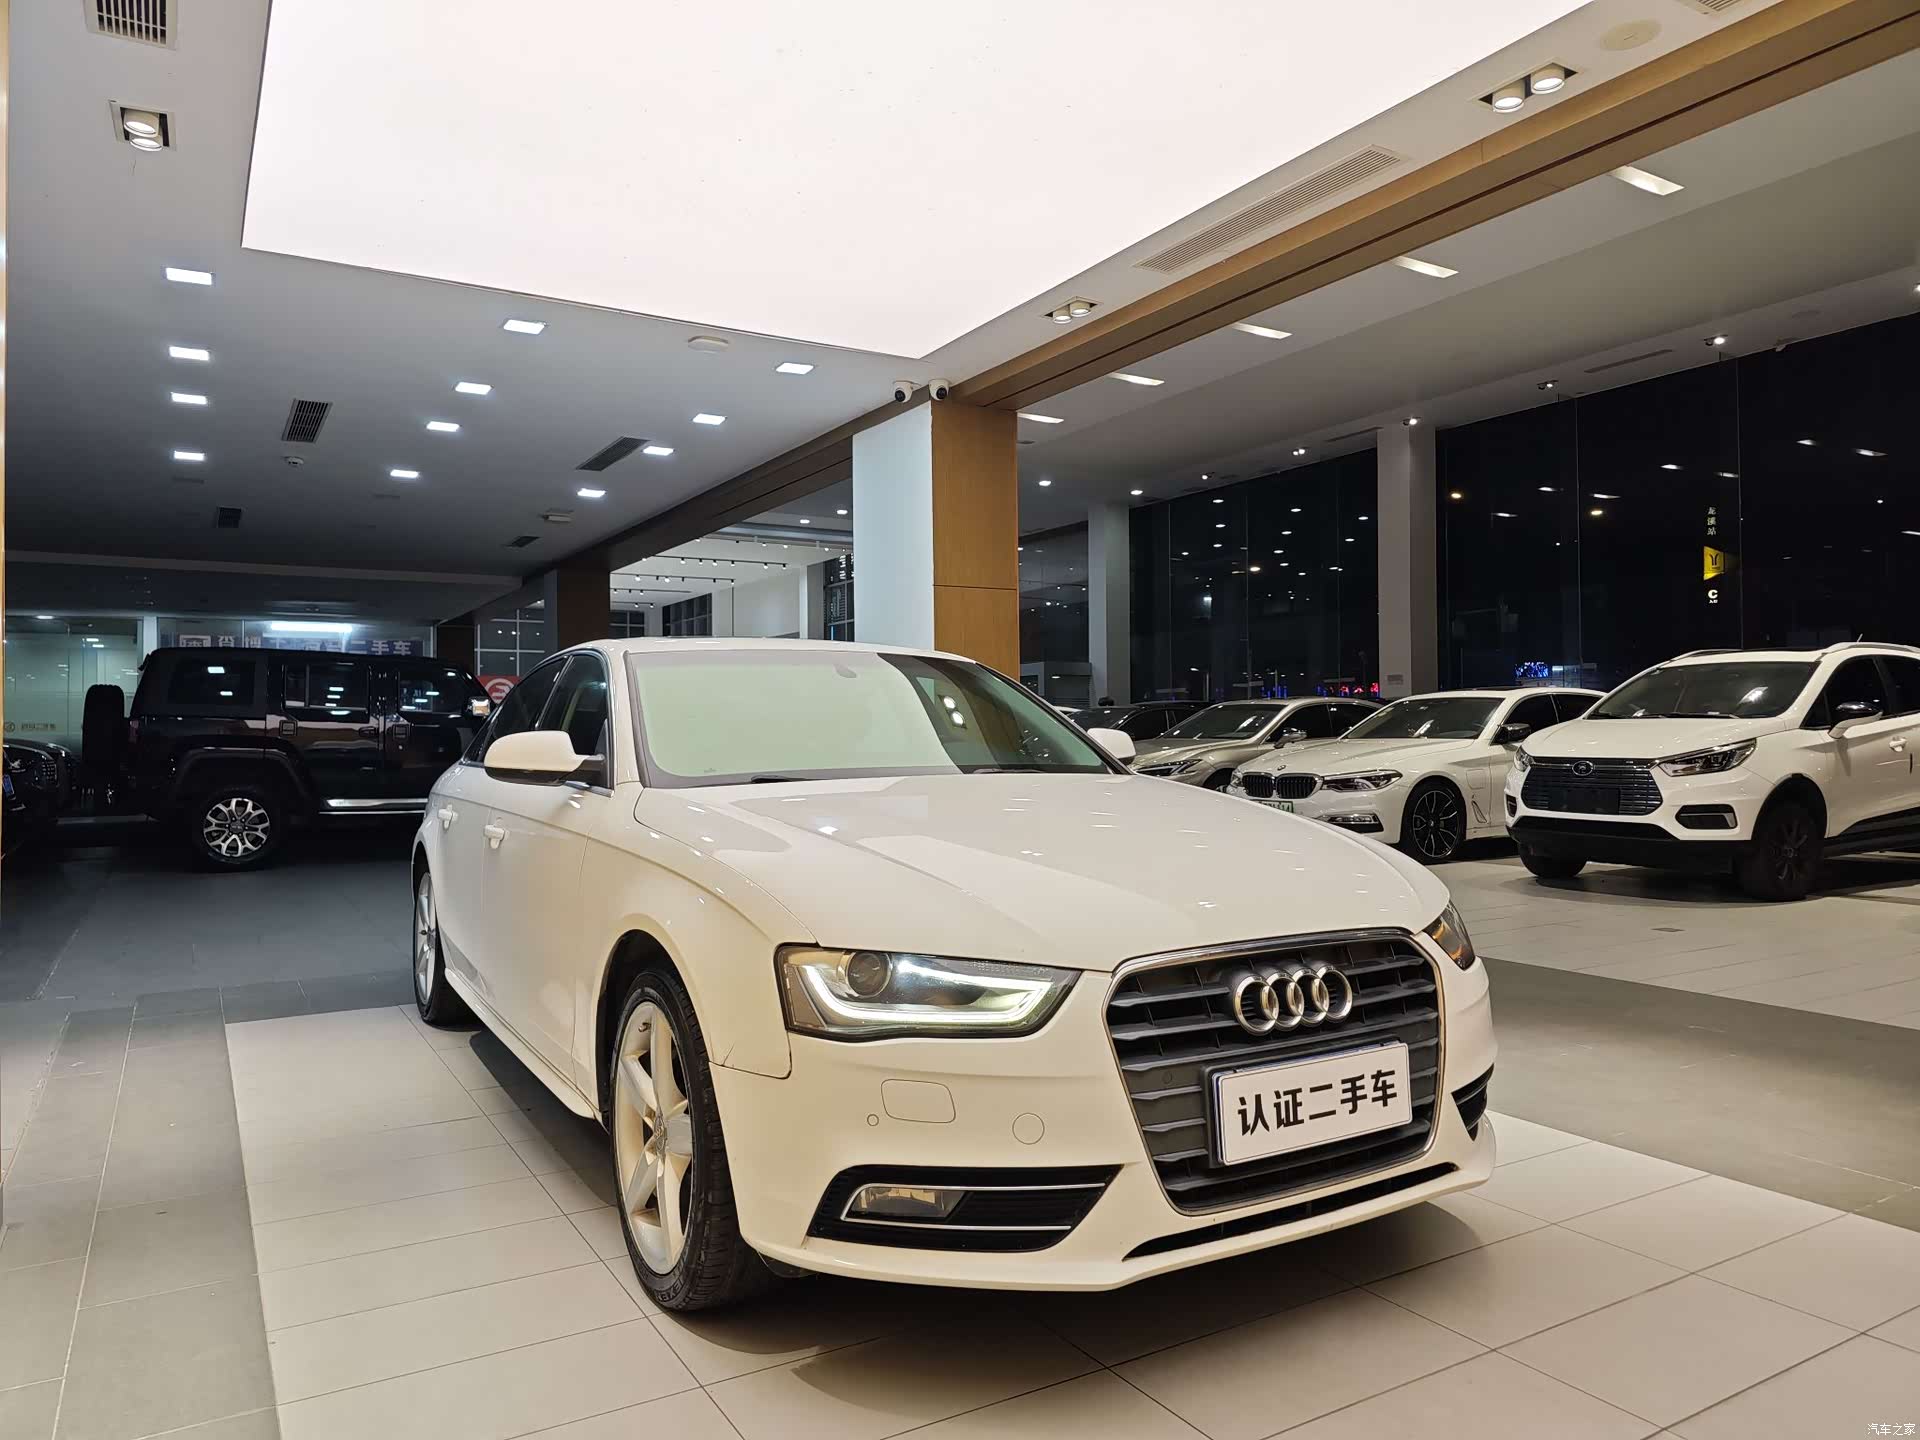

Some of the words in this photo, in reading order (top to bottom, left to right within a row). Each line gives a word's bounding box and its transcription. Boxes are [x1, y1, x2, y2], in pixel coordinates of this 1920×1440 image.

[1707, 589, 1719, 599] C
[1237, 1069, 1398, 1136] 认证二手车
